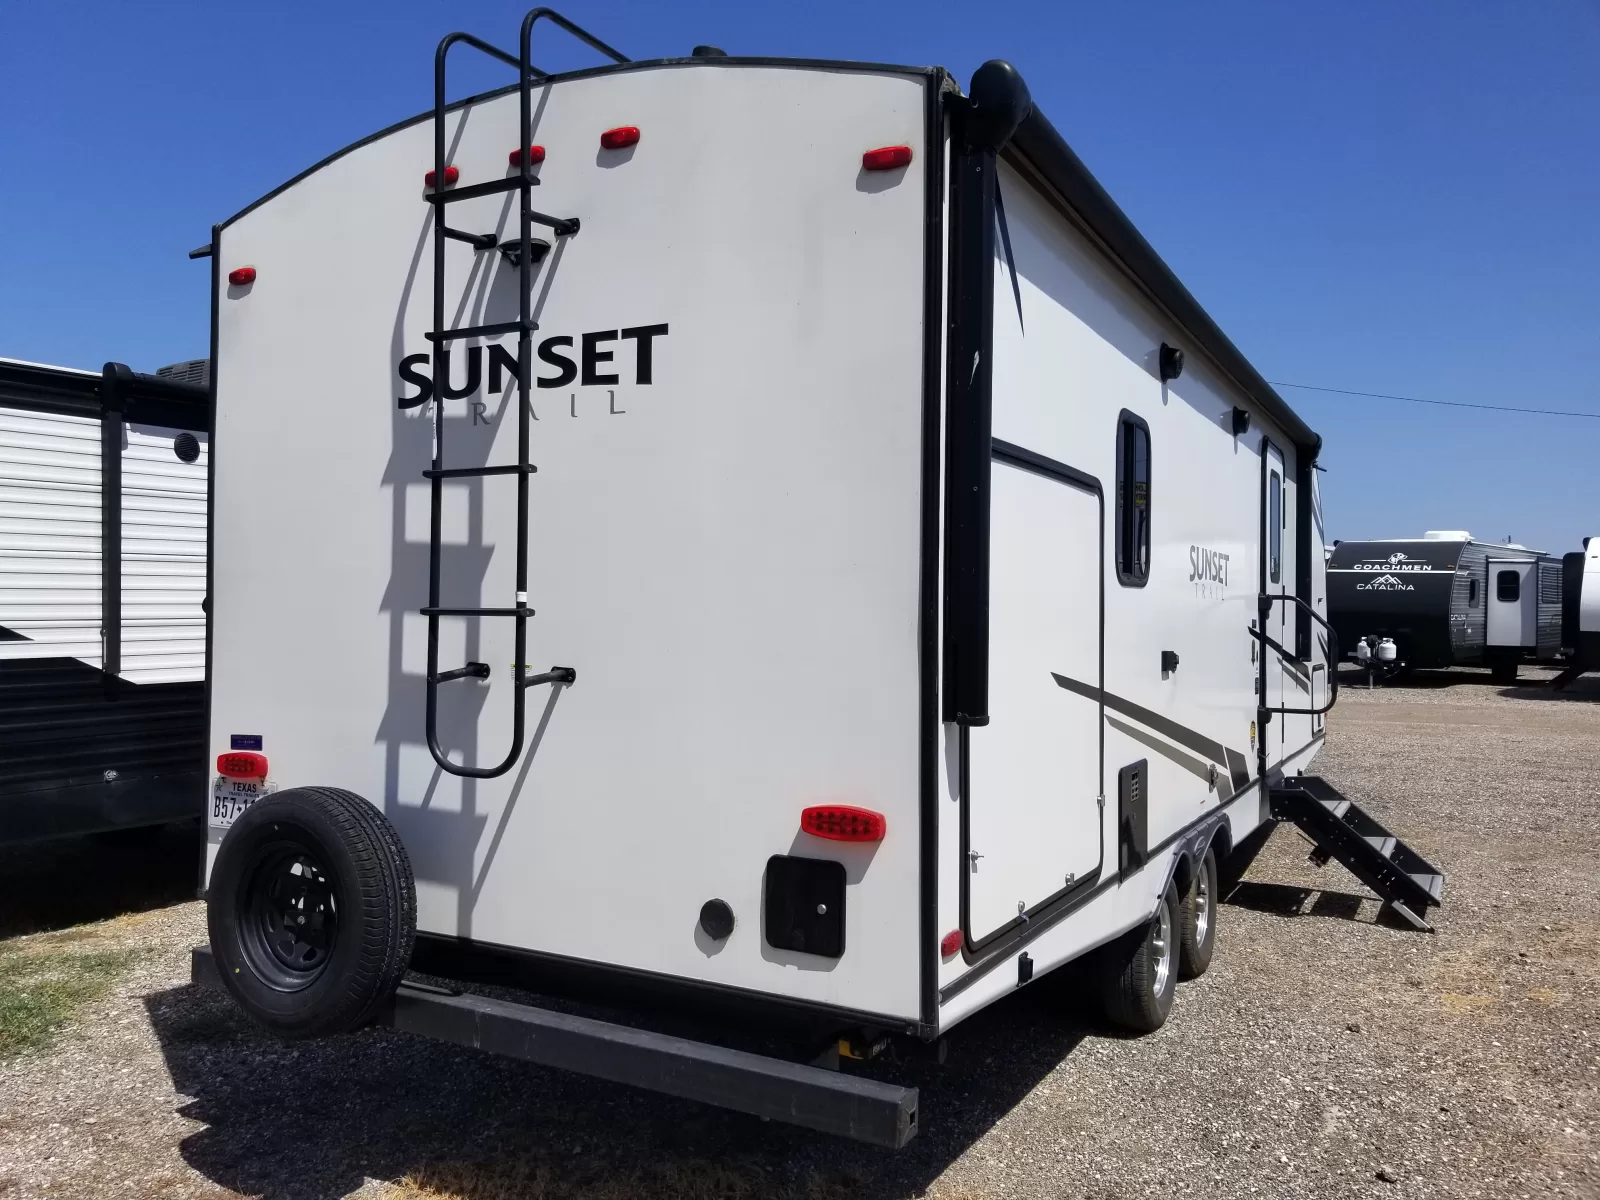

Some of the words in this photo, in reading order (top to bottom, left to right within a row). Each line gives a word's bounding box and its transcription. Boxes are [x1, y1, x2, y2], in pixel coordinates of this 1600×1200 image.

[398, 323, 669, 410] SUNSET
[1189, 544, 1230, 587] SUNSET
[1356, 583, 1415, 591] CATALINA
[232, 781, 257, 793] TEXAS
